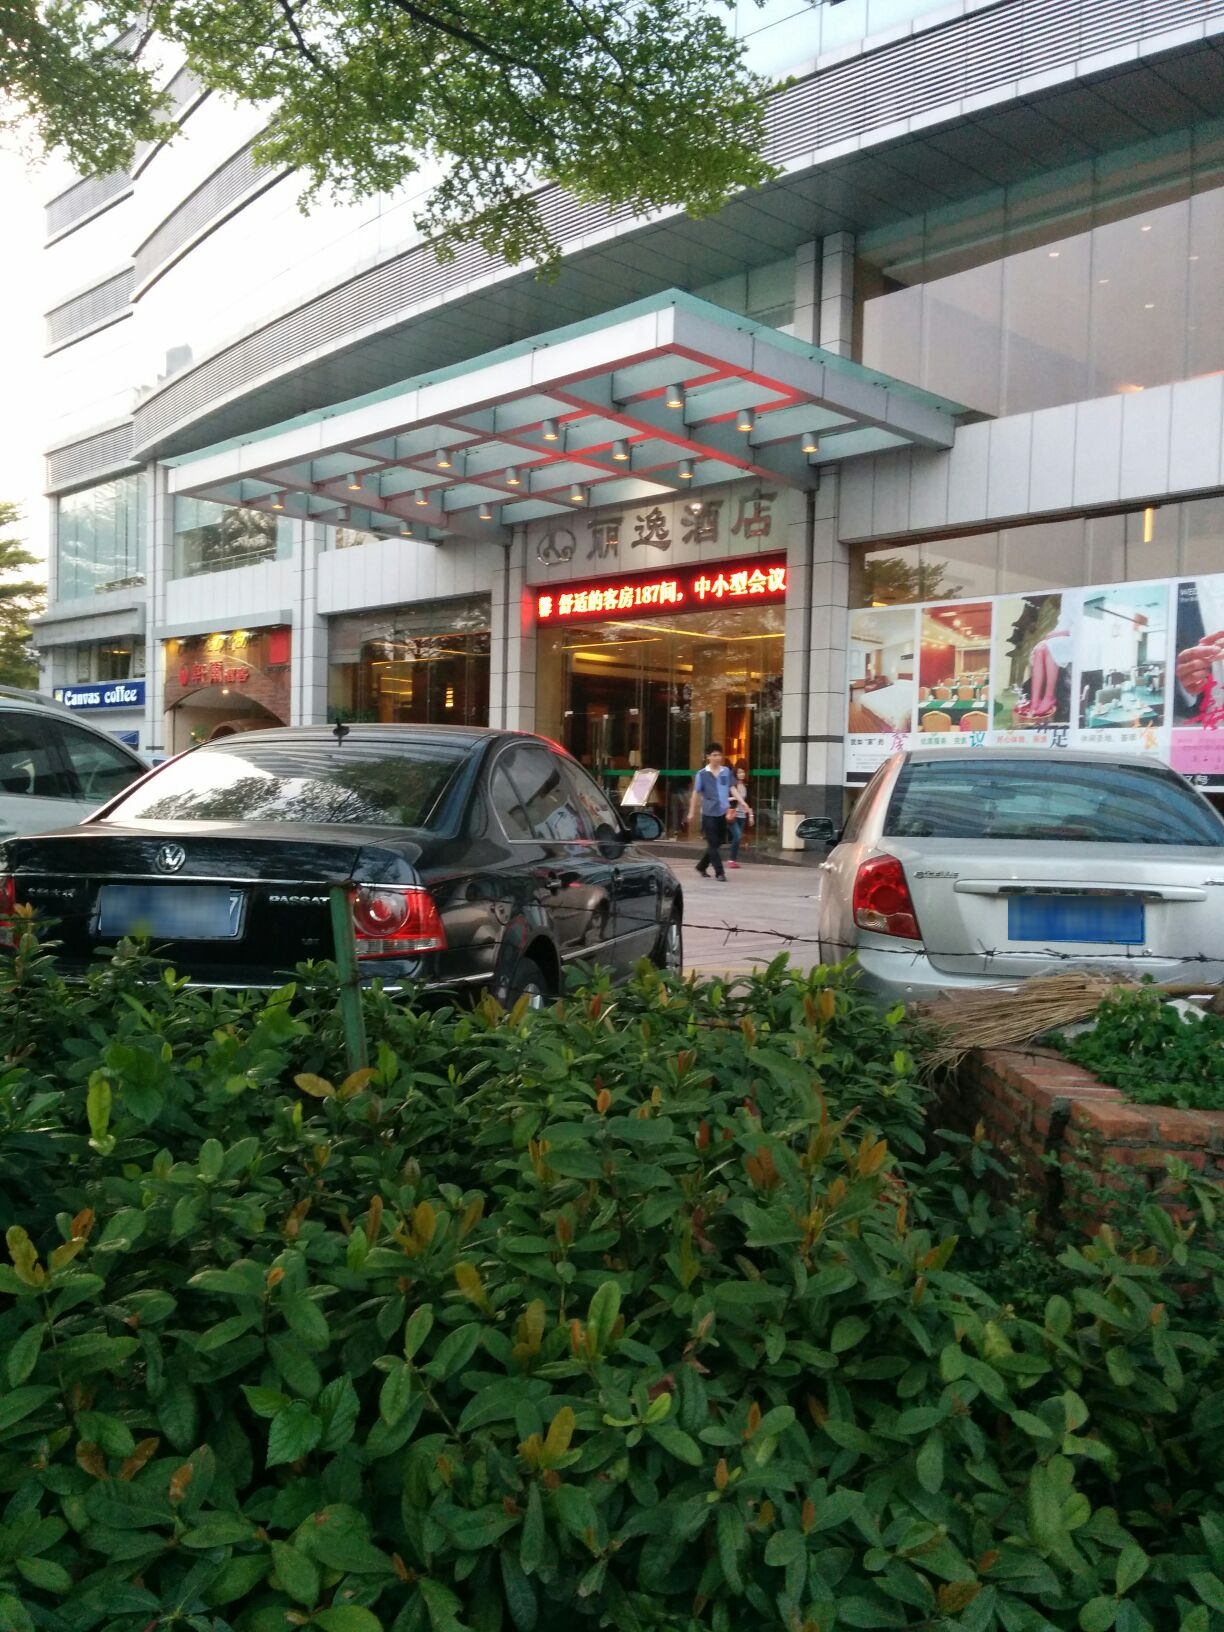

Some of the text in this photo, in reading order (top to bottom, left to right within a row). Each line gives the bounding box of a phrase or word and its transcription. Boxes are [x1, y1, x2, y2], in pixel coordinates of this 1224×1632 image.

[587, 488, 777, 559] 丽逸酒店
[64, 686, 138, 706] Canvas coffee
